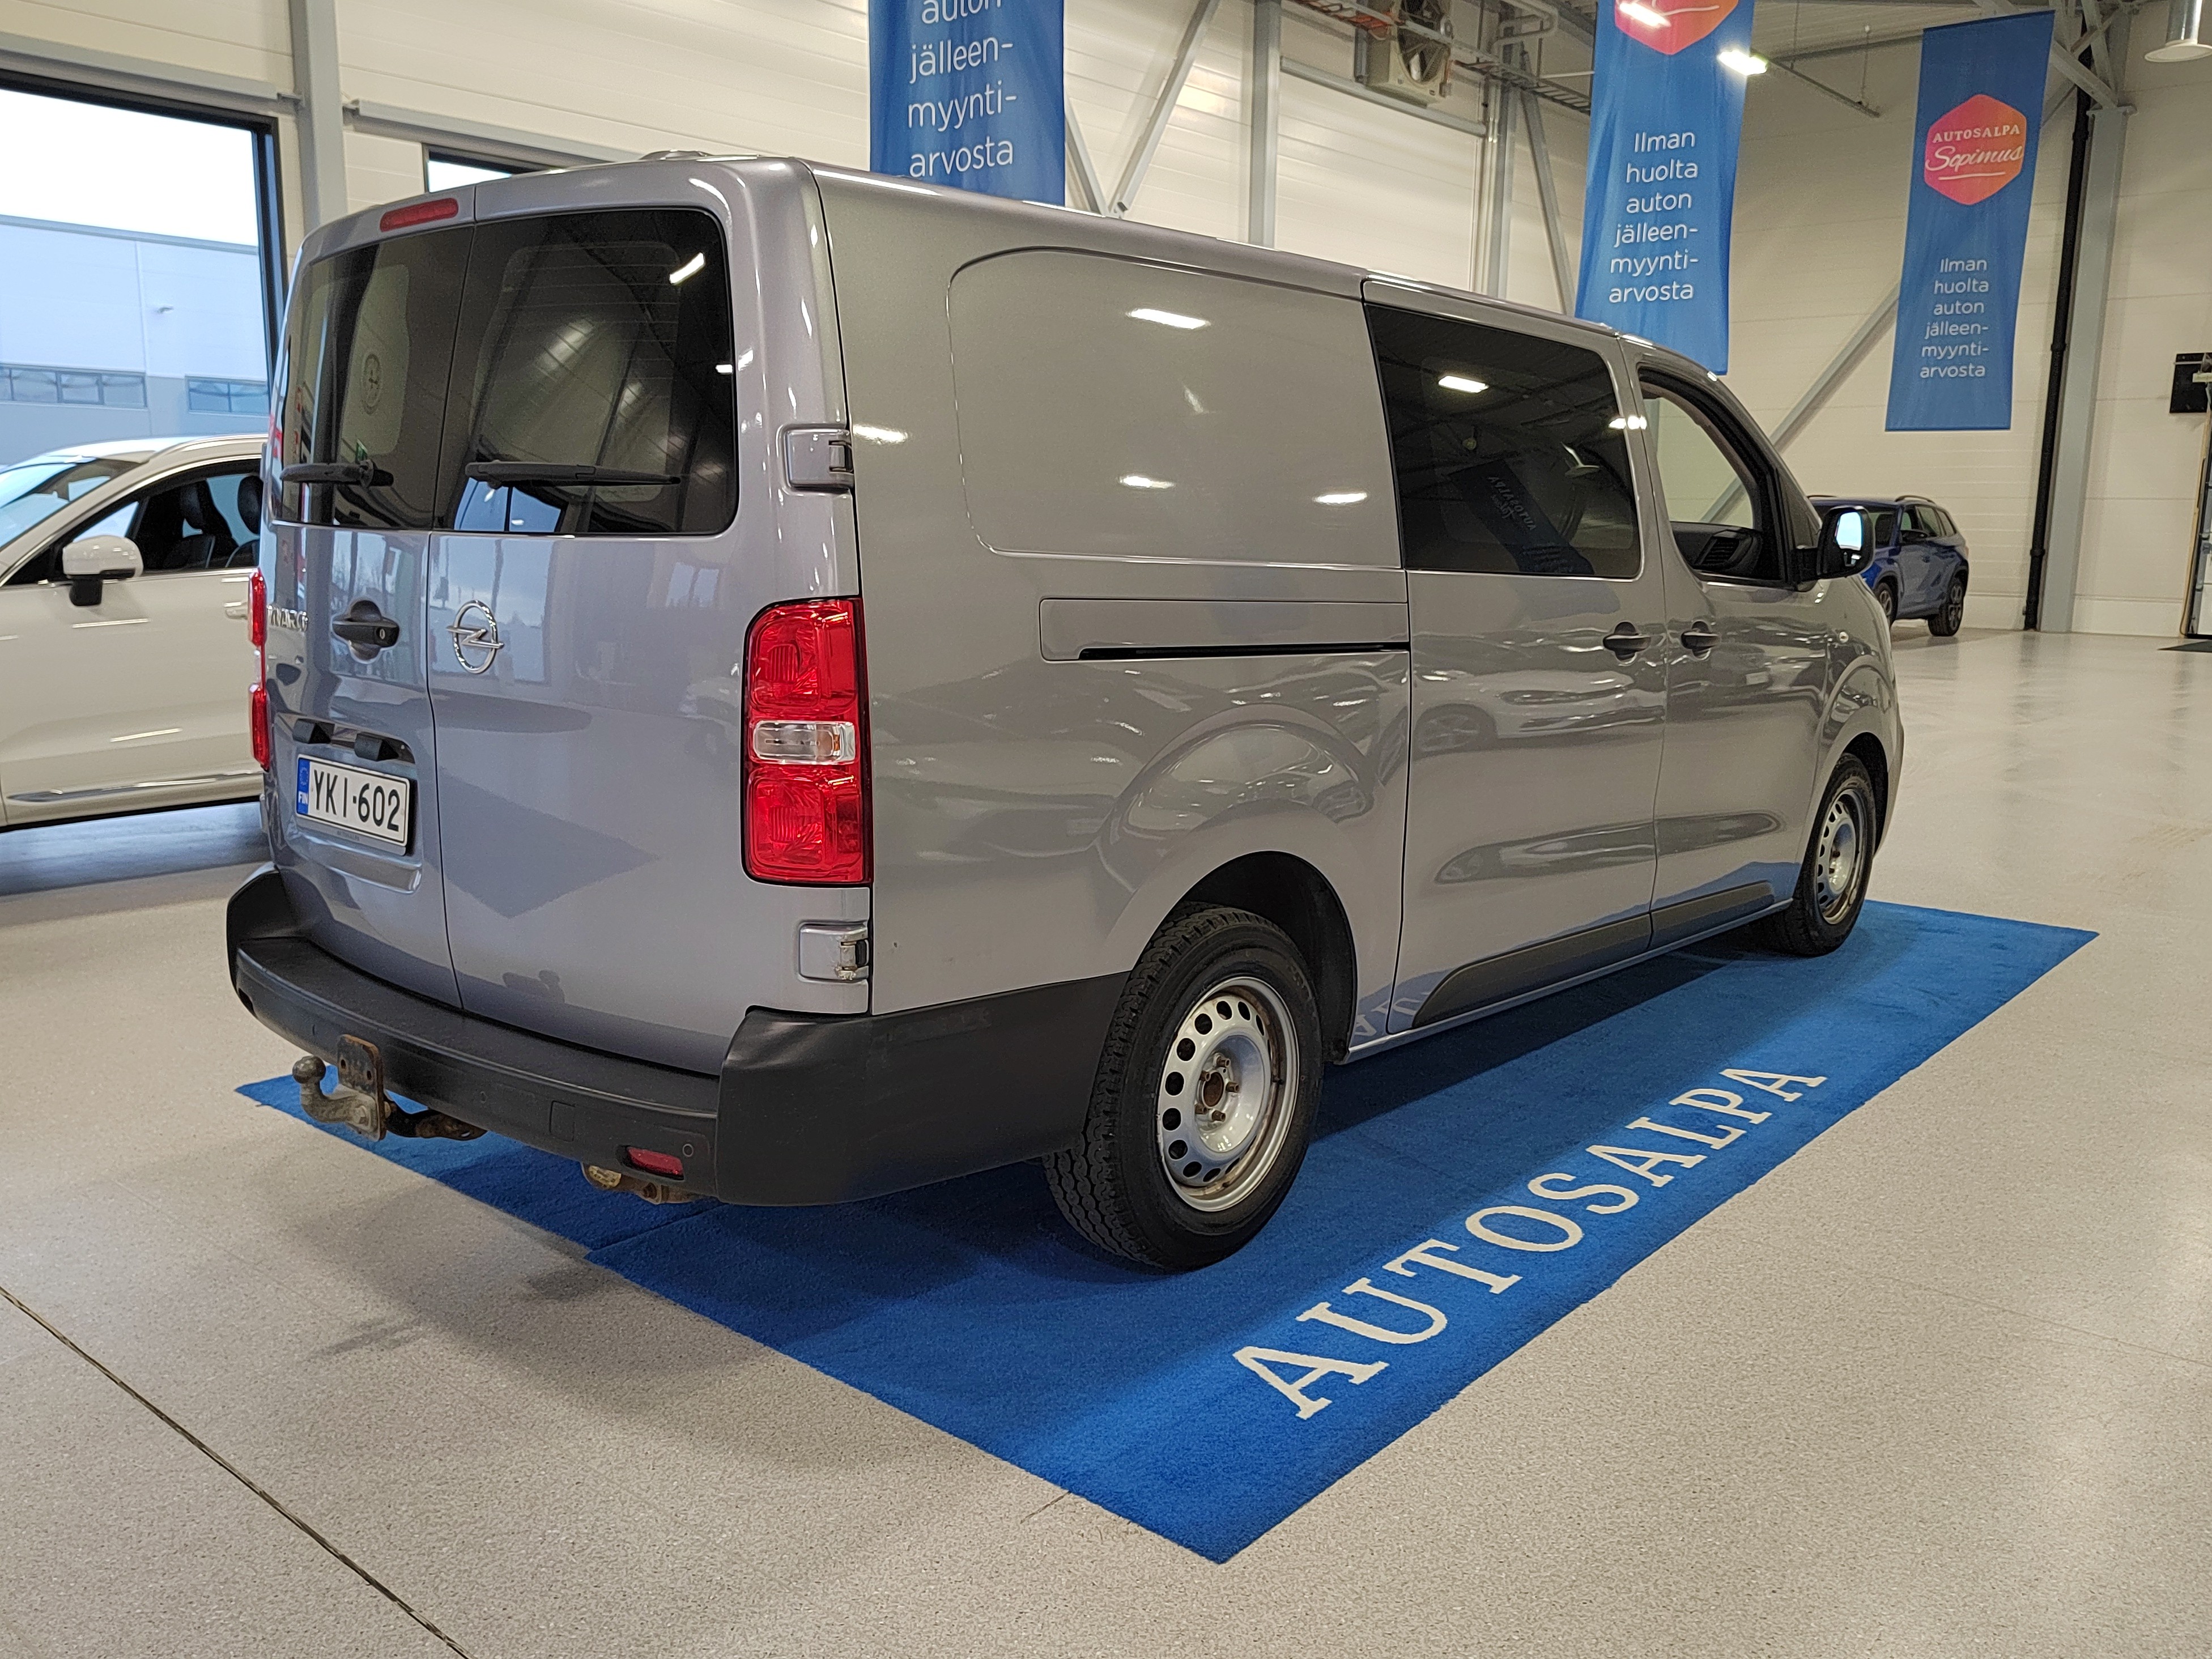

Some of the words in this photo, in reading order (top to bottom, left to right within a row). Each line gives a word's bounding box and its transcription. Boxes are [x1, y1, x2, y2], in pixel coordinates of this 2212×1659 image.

[909, 36, 1013, 84] jälleen-
[908, 80, 1017, 132] myynti-
[1634, 131, 1695, 152] Ilman
[1933, 124, 2020, 143] AUTOSALPA
[909, 136, 1014, 177] arvosta
[1626, 159, 1698, 183] huolta
[1626, 192, 1692, 214] auton
[1613, 222, 1698, 248] jälleen-
[1610, 248, 1699, 276] myynti-
[1940, 258, 1987, 273] Ilman
[1609, 281, 1694, 303] arvosta
[1934, 277, 1989, 294] huolta
[1933, 300, 1984, 315] auton
[1924, 320, 1989, 339] jälleen-
[1921, 341, 1989, 359] myynti-
[1920, 363, 1985, 378] arvosta
[299, 793, 308, 805] FIN
[314, 769, 400, 832] YKI-602
[1232, 1067, 1827, 1420] AUTOSALPA
